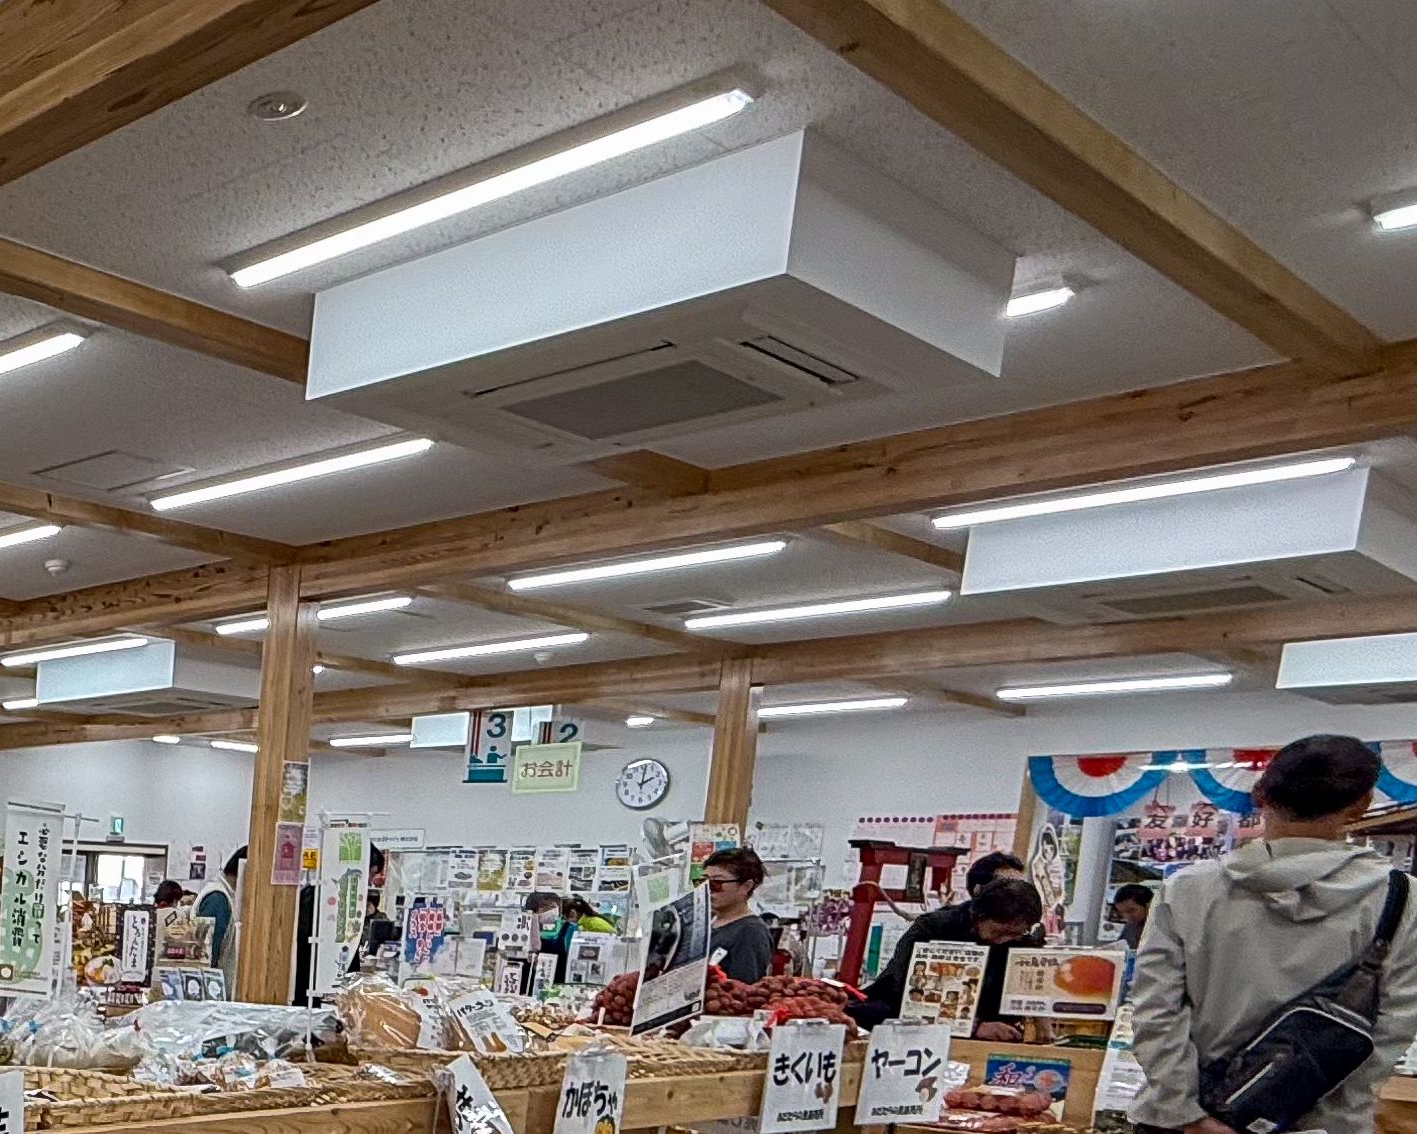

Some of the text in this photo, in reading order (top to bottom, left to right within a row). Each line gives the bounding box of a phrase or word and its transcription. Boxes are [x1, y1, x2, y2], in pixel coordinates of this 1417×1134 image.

[486, 713, 507, 739] 3
[559, 722, 579, 744] 2
[520, 759, 573, 778] お会計
[11, 830, 30, 948] エシカル消費
[772, 1050, 837, 1087] きくいも
[870, 1047, 942, 1079] ヤーコン
[561, 1080, 619, 1119] かぼちゃ
